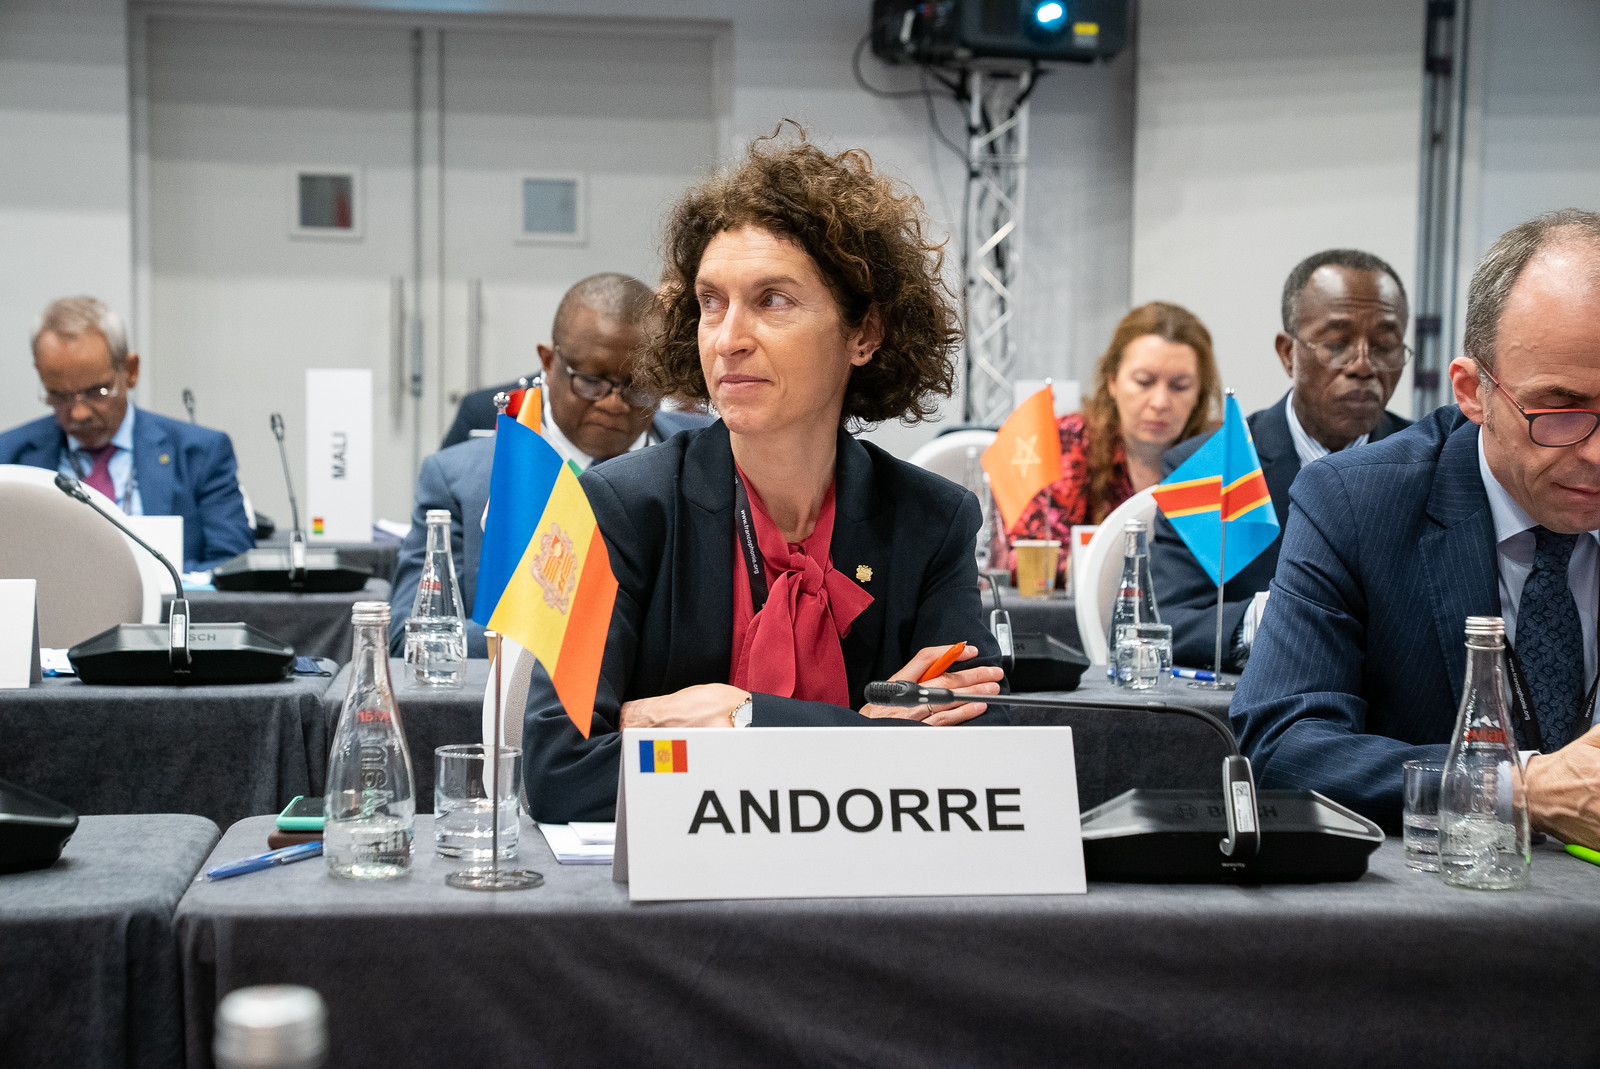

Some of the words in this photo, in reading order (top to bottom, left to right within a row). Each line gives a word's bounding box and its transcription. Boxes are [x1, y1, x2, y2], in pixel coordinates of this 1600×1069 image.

[331, 431, 347, 480] MALI
[740, 509, 759, 575] www.francophonie.org
[188, 633, 216, 641] SCH
[688, 788, 1025, 834] ANDORRE
